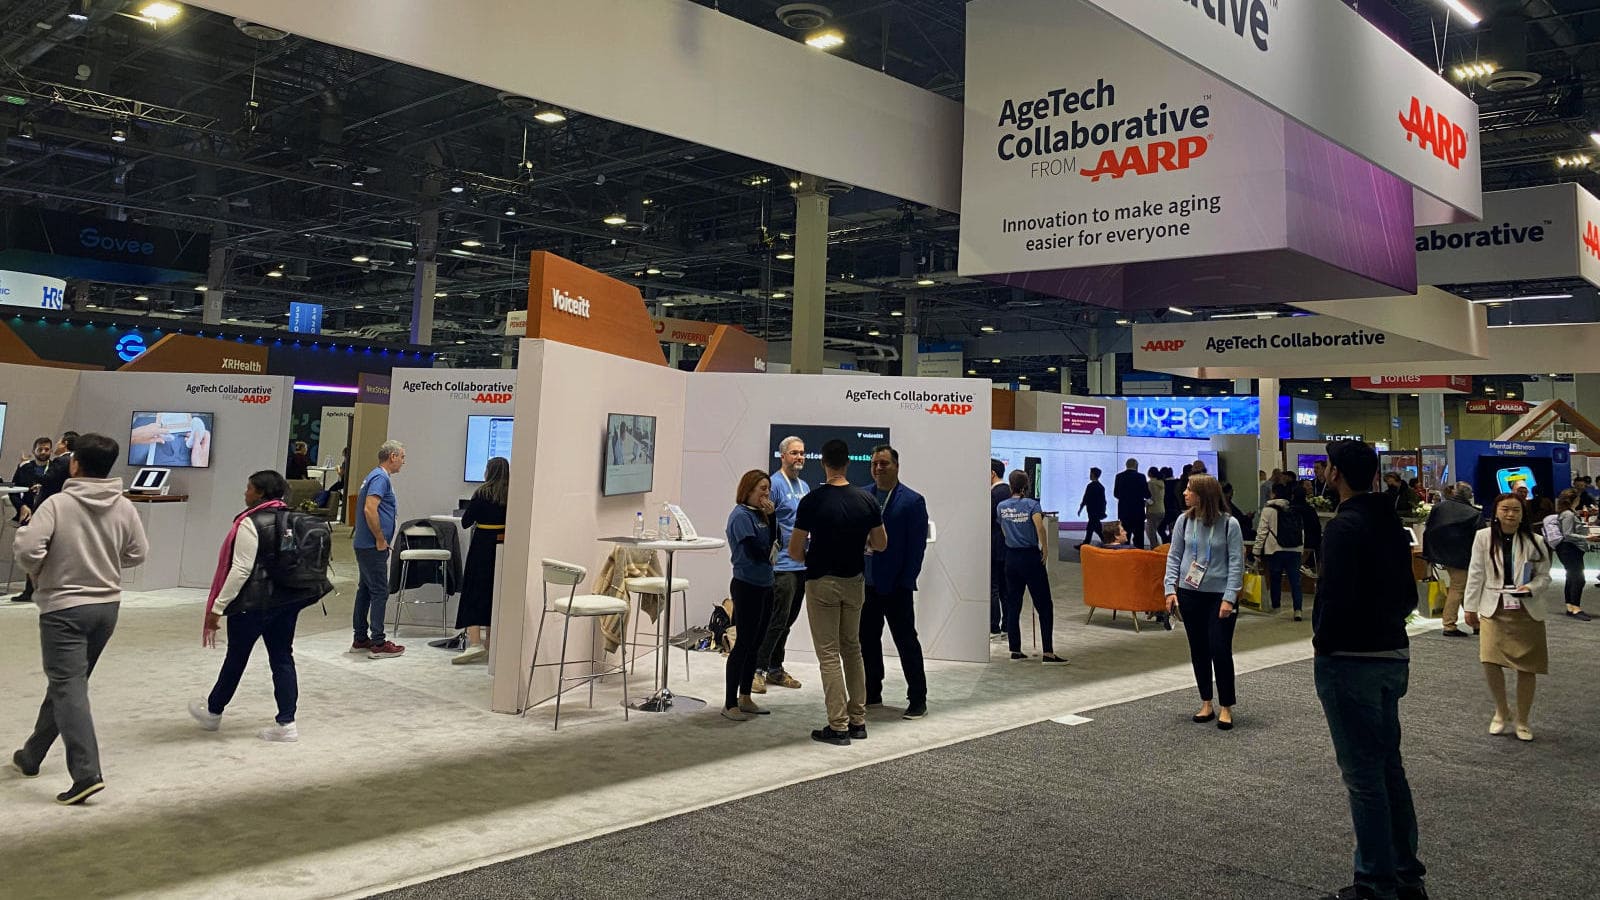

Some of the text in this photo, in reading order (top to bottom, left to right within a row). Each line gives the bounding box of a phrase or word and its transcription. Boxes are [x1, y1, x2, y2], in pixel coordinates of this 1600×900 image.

[998, 78, 1115, 131] AgeTech
[997, 102, 1210, 161] Collaborative
[1398, 95, 1467, 170] AARP
[1031, 135, 1208, 183] FROM AARP
[1002, 194, 1221, 233] Innovation to make aging
[79, 227, 154, 255] Govee
[1025, 222, 1190, 251] easier for everyone
[552, 288, 590, 318] Voiceitt
[1141, 329, 1386, 353] AARP AgeTech Collaborative
[221, 358, 261, 372] XRHealth
[186, 384, 272, 394] AgeTech Collaborative
[402, 380, 514, 392] AgeTech Collaborative
[471, 393, 513, 403] AARP
[846, 389, 973, 403] AgeTech Collaborative
[239, 394, 271, 404] AARP
[900, 402, 973, 415] FROM AARP
[1489, 442, 1536, 451] Mental Fitness
